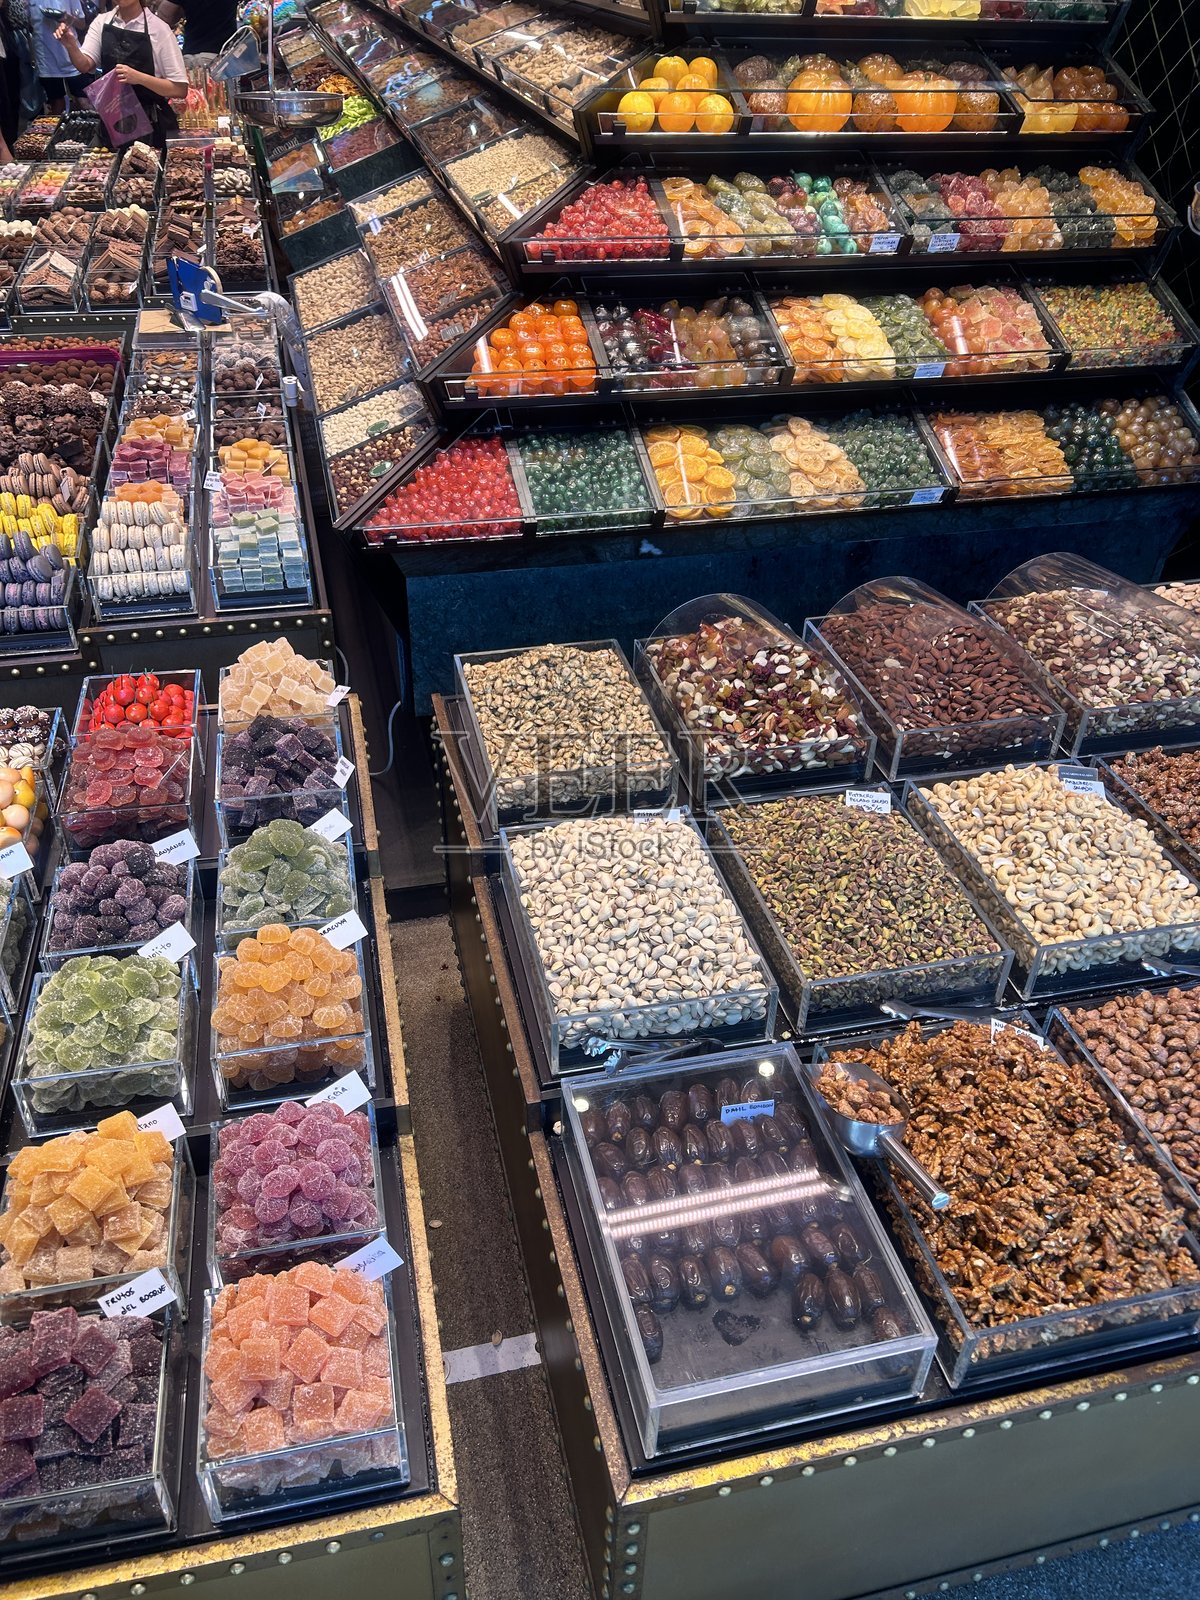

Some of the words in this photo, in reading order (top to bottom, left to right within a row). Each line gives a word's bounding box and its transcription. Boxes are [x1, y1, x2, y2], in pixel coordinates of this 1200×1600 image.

[0, 849, 15, 860] ANA
[319, 918, 347, 936] ARACUYA
[137, 1119, 158, 1132] tano
